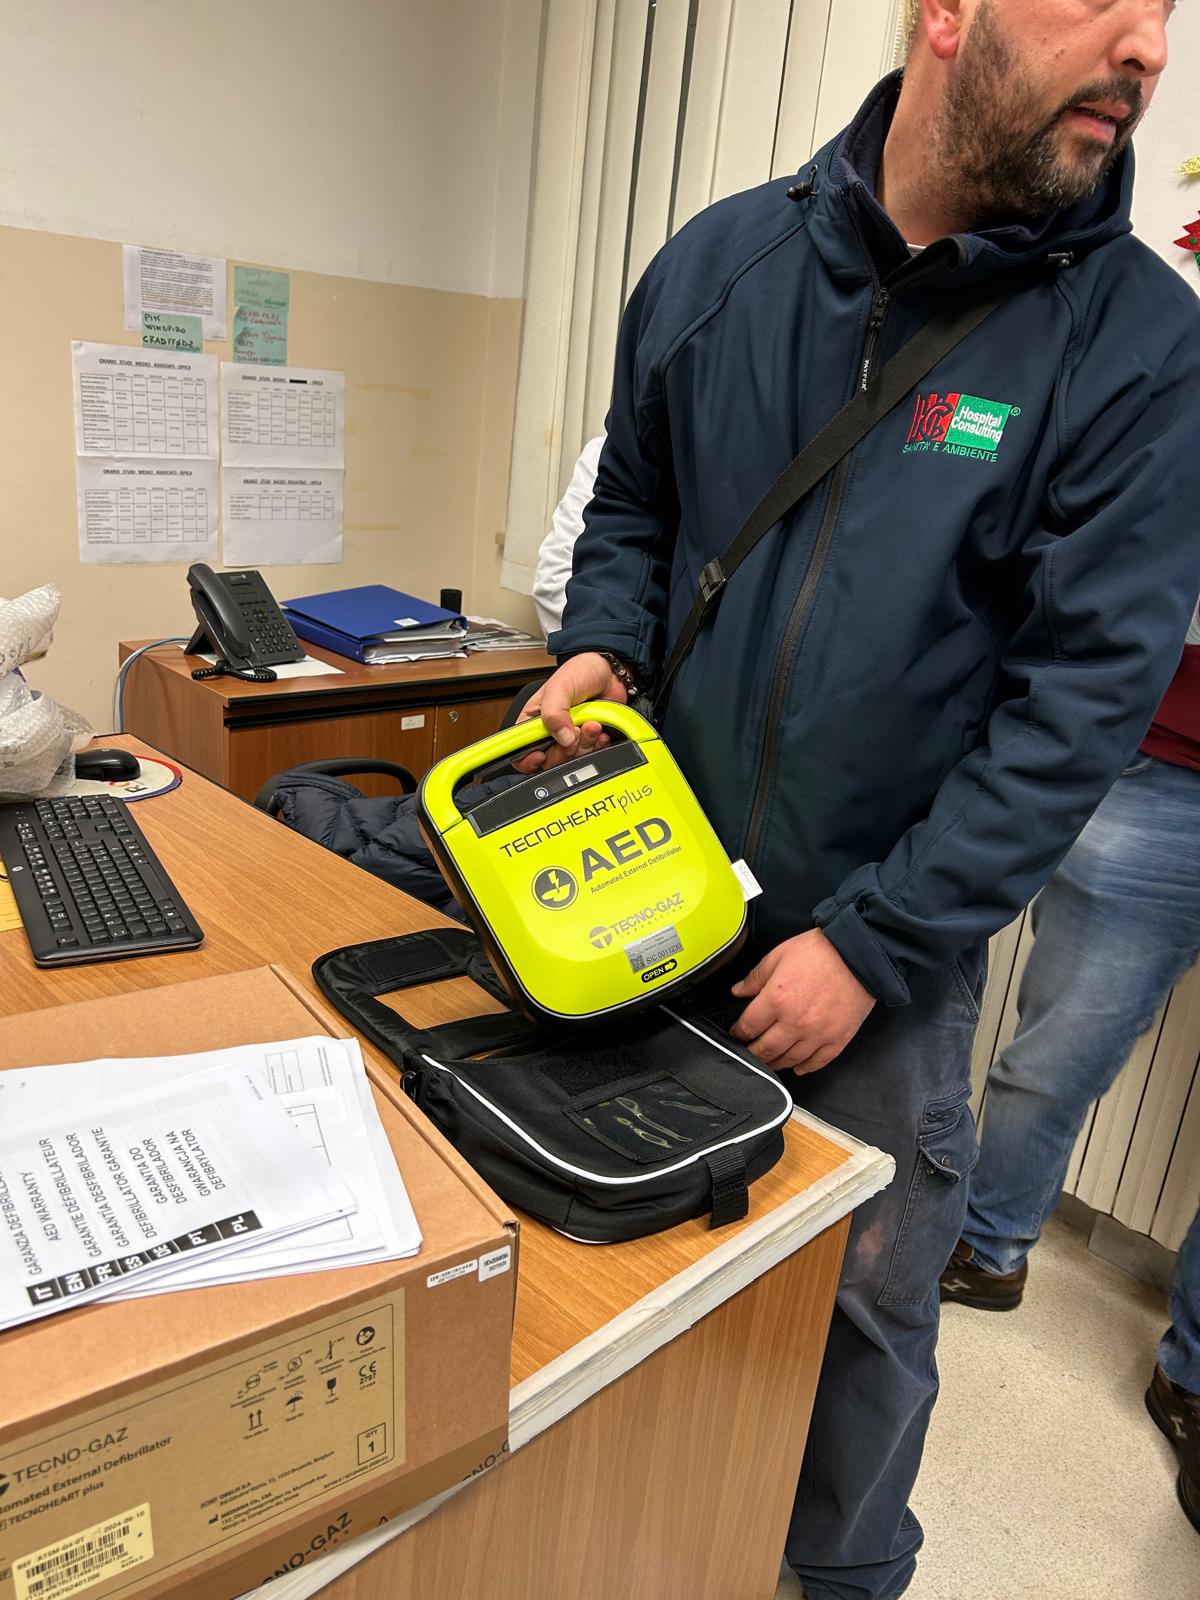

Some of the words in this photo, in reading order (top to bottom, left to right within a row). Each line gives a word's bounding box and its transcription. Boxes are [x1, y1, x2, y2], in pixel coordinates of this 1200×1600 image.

[99, 358, 117, 366] ORARIO
[951, 416, 1003, 442] Consulting
[959, 405, 1002, 427] Hospital
[933, 442, 940, 451] E
[942, 444, 998, 462] AMBIENTE
[500, 794, 617, 858] TECNOHEART
[617, 784, 653, 814] plus
[581, 817, 672, 883] AED
[590, 873, 623, 894] Automated
[624, 861, 648, 878] External
[648, 845, 682, 865] Defibrillator
[609, 892, 684, 937] TECNO-GAZ
[643, 967, 664, 981] OPEN
[92, 1126, 123, 1173] GARANTIE
[129, 1147, 144, 1162] DO
[165, 1130, 181, 1146] NA
[66, 1132, 107, 1203] DESFIBRILADOR
[142, 1137, 188, 1204] DESFIBRILADOR
[174, 1146, 211, 1197] GWARANCJA
[182, 1128, 226, 1191] DEFIBRYLATOR
[20, 1172, 52, 1223] WARRANTY
[138, 1160, 168, 1205] GARANTIA
[112, 1168, 157, 1239] DEFIBRILLATOR
[43, 1223, 62, 1241] AED
[69, 1211, 102, 1257] GARANTIE
[188, 1230, 208, 1246] PT
[232, 1216, 249, 1234] PL
[13, 1230, 42, 1275] GARANZIA
[127, 1254, 144, 1271] ES
[153, 1243, 172, 1258] DE
[68, 1272, 86, 1293] EN
[99, 1263, 115, 1282] FR
[35, 1285, 54, 1300] IT
[366, 1429, 378, 1438] QTY
[368, 1441, 374, 1452] 1
[13, 1426, 129, 1484] TECNO-GAZ
[53, 1464, 101, 1492] External
[103, 1436, 173, 1471] Defibrillator
[9, 1489, 82, 1526] TECNOHEART
[82, 1481, 105, 1497] plus
